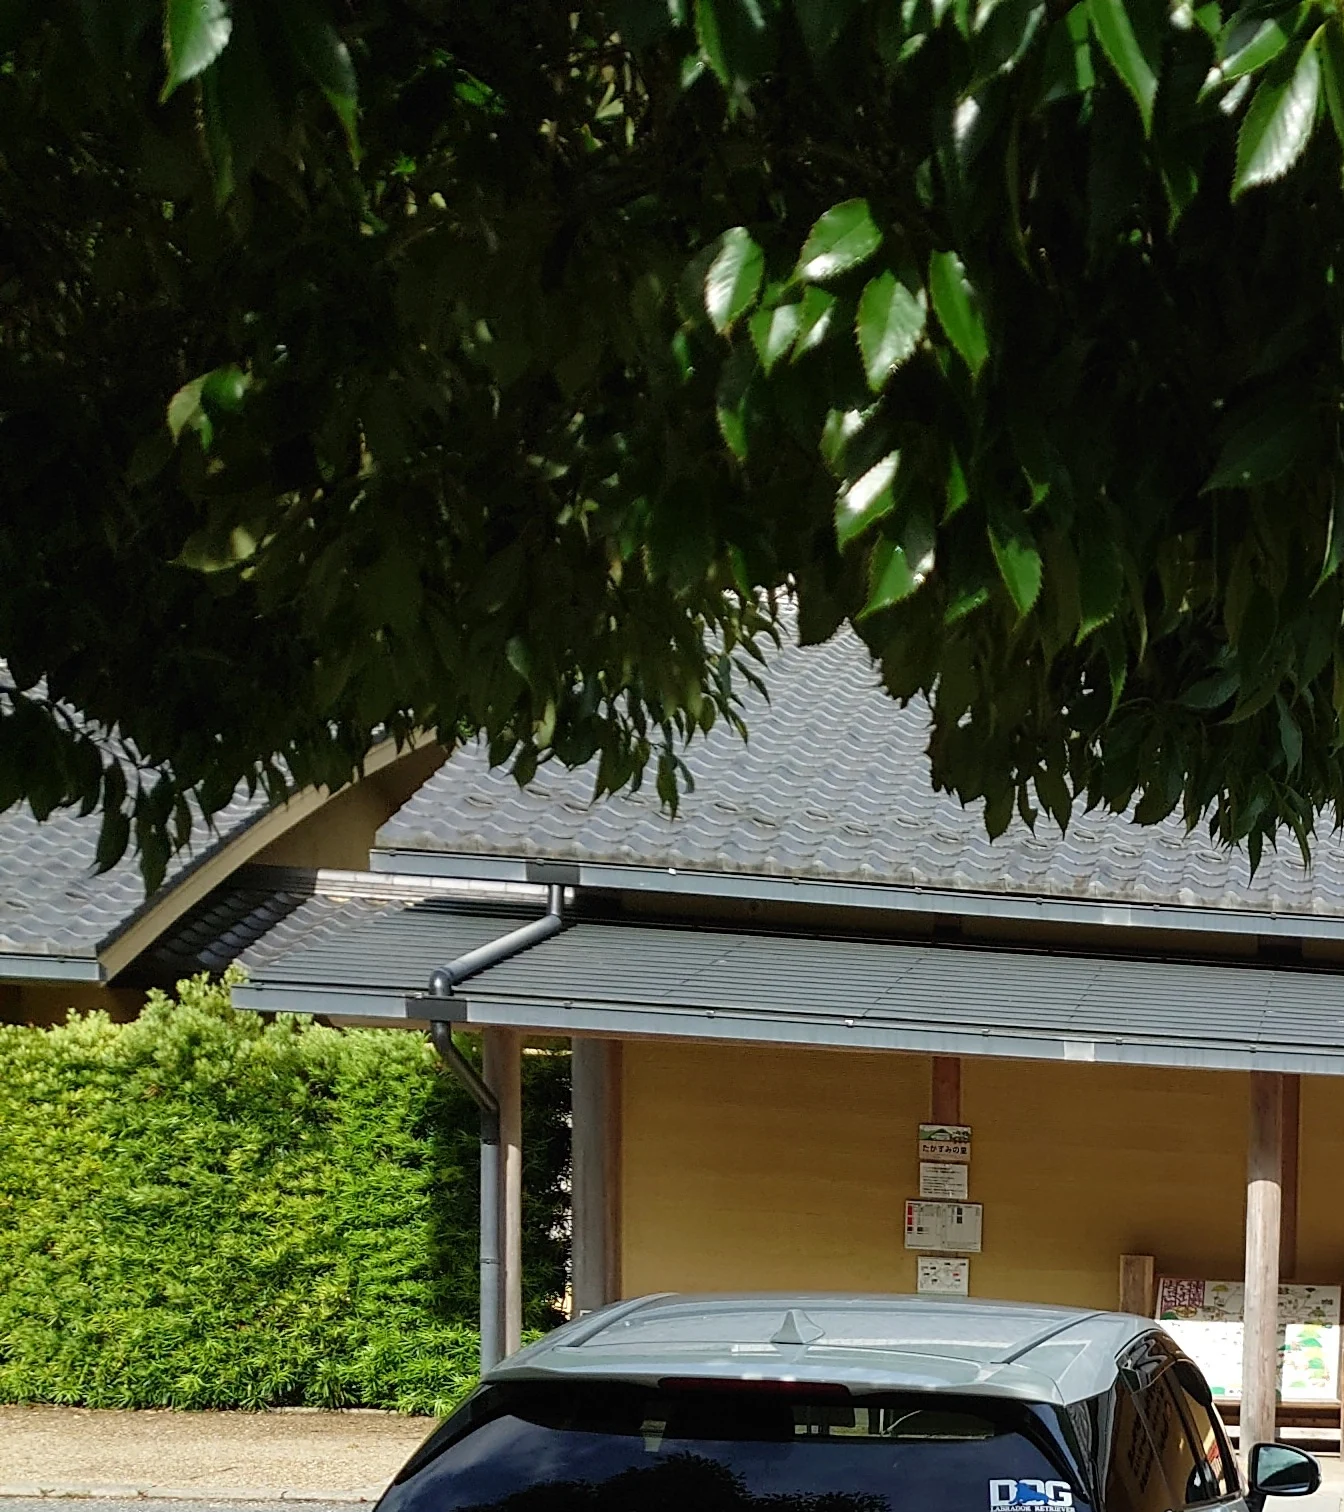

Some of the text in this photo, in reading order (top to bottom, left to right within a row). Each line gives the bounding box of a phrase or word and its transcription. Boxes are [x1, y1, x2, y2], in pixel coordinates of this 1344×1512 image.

[922, 1144, 967, 1154] たかすみの里
[989, 1479, 1073, 1507] DOG
